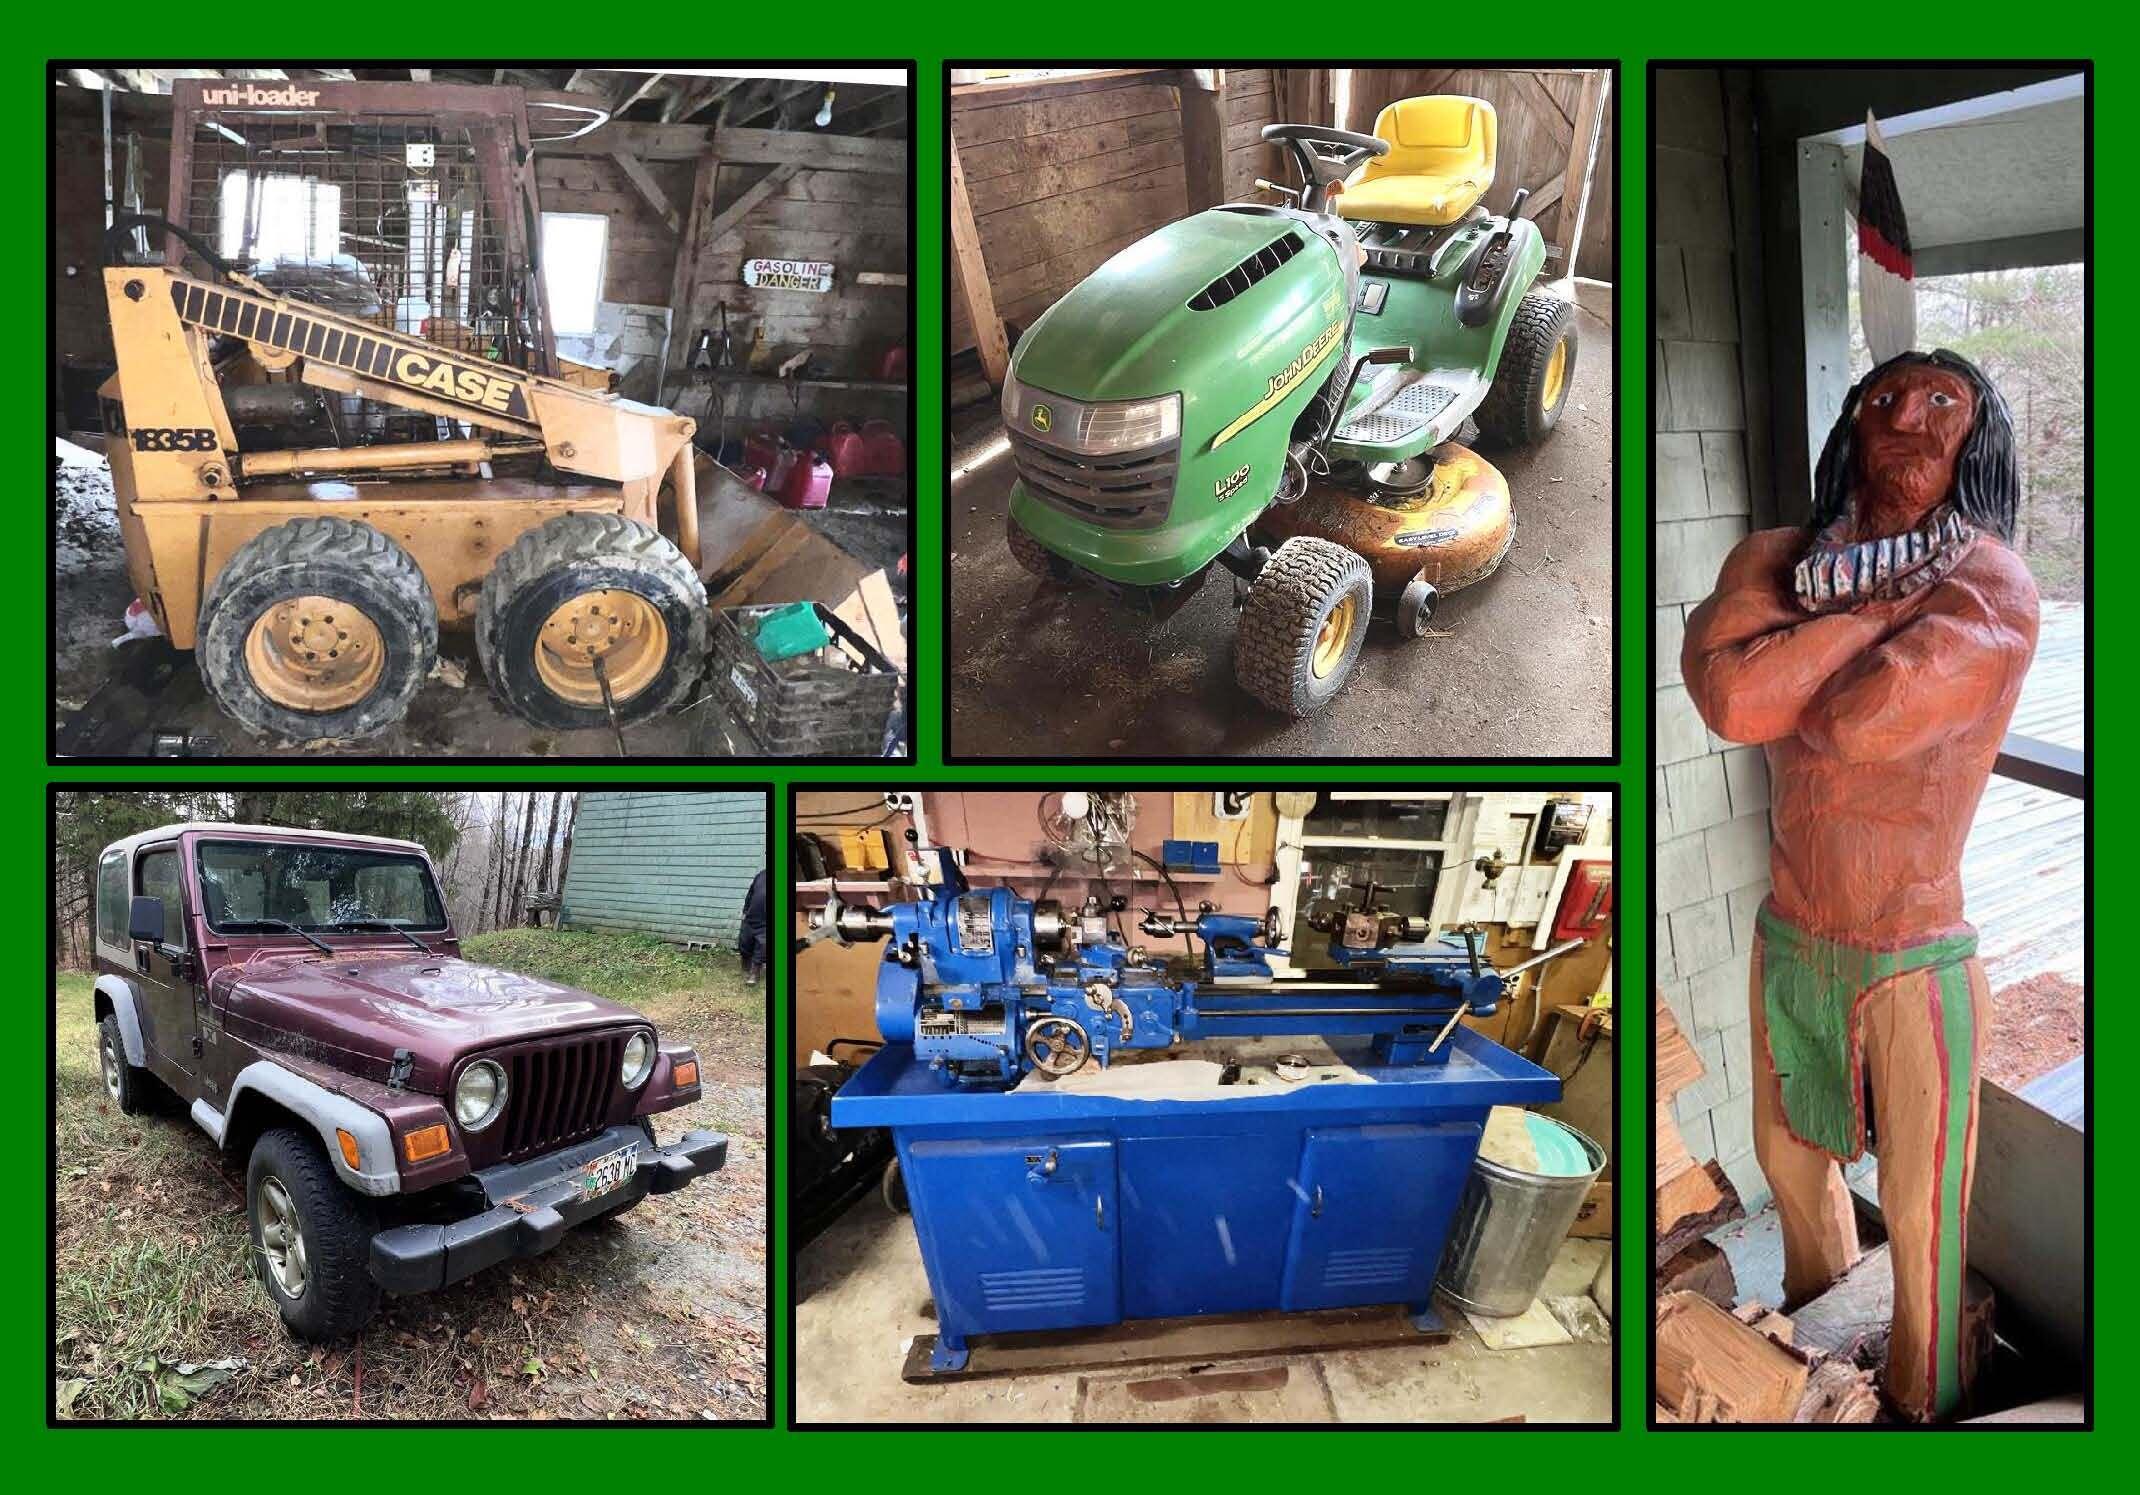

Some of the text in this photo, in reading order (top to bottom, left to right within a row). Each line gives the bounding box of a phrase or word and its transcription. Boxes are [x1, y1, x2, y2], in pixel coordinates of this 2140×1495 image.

[202, 83, 320, 106] uni-loader
[754, 261, 829, 276] GASOLINE
[760, 272, 818, 289] DANGER
[1264, 319, 1341, 400] JOHN DEERE
[396, 353, 515, 411] CASE
[130, 428, 218, 452] 1835B
[1215, 463, 1251, 497] L100
